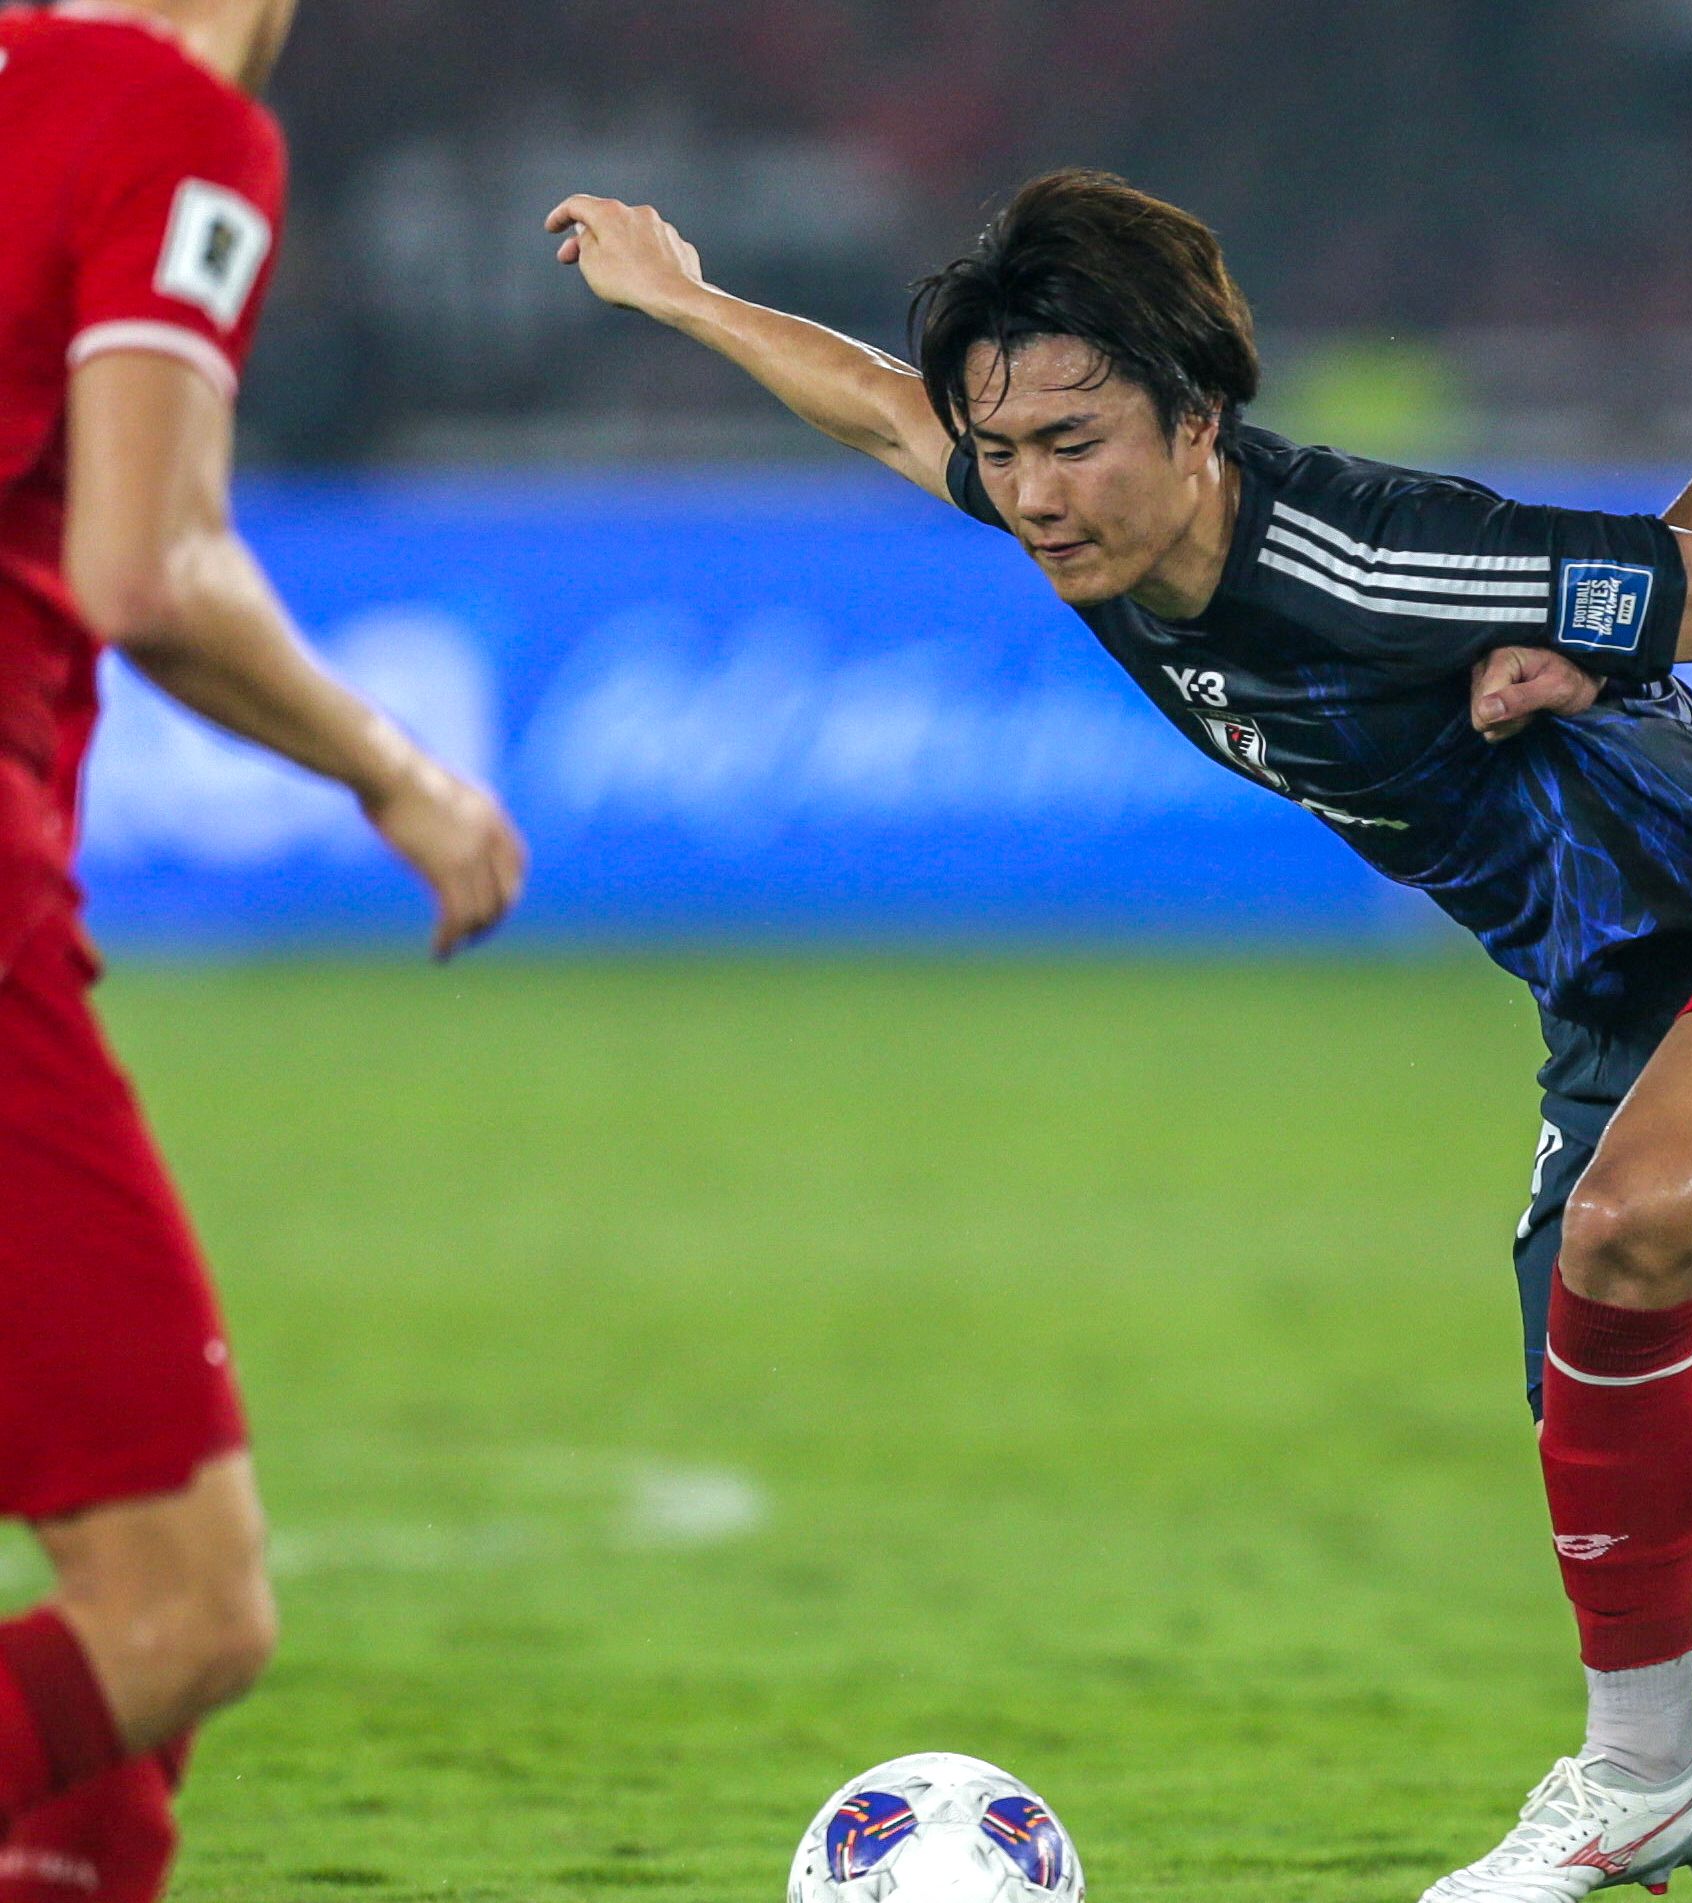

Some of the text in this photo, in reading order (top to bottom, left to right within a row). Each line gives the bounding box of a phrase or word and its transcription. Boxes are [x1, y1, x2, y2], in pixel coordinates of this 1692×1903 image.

[1572, 579, 1591, 629] FOOTBALL
[1586, 579, 1611, 632] UNITES
[1621, 598, 1633, 621] FIFA
[1161, 665, 1228, 708] Y-3
